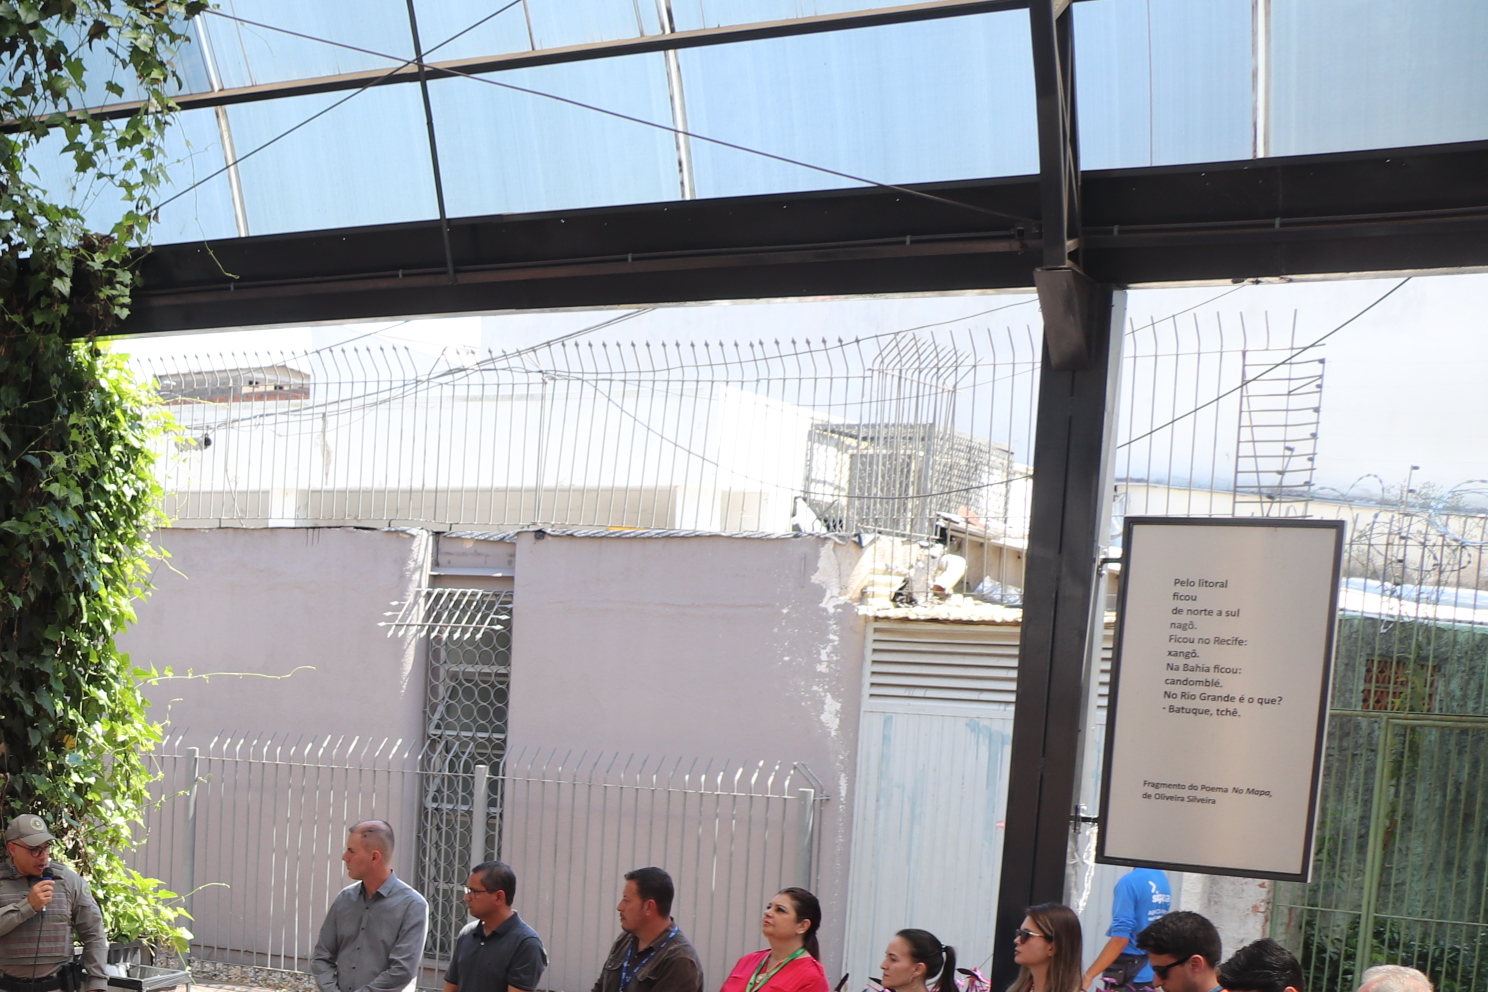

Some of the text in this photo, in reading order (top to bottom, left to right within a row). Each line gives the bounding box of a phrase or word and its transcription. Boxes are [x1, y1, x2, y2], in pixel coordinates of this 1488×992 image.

[1174, 578, 1228, 588] Pelo litoral
[1173, 592, 1197, 601] ficou
[1171, 607, 1183, 615] de
[1186, 608, 1213, 616] norte
[1225, 609, 1240, 617] sul
[1170, 621, 1197, 631] nagô.
[1169, 635, 1195, 644] Ficou
[1213, 637, 1247, 646] Recife:
[1167, 649, 1199, 659] xangô.
[1166, 663, 1242, 674] Na Bahia ficou:
[1165, 678, 1223, 688] candomblé.
[1164, 691, 1178, 699] No
[1180, 692, 1196, 700] Rio
[1199, 693, 1236, 703] Grande
[1239, 695, 1244, 703] é
[1257, 696, 1283, 706] que?
[1169, 705, 1213, 716] Batuque,
[1216, 708, 1241, 717] tchê.
[1143, 780, 1186, 790] Fragmento
[1201, 785, 1228, 793] Poema
[1245, 788, 1272, 798] Mapa,
[1154, 793, 1185, 802] Oliveira
[1187, 795, 1216, 804] Silveira
